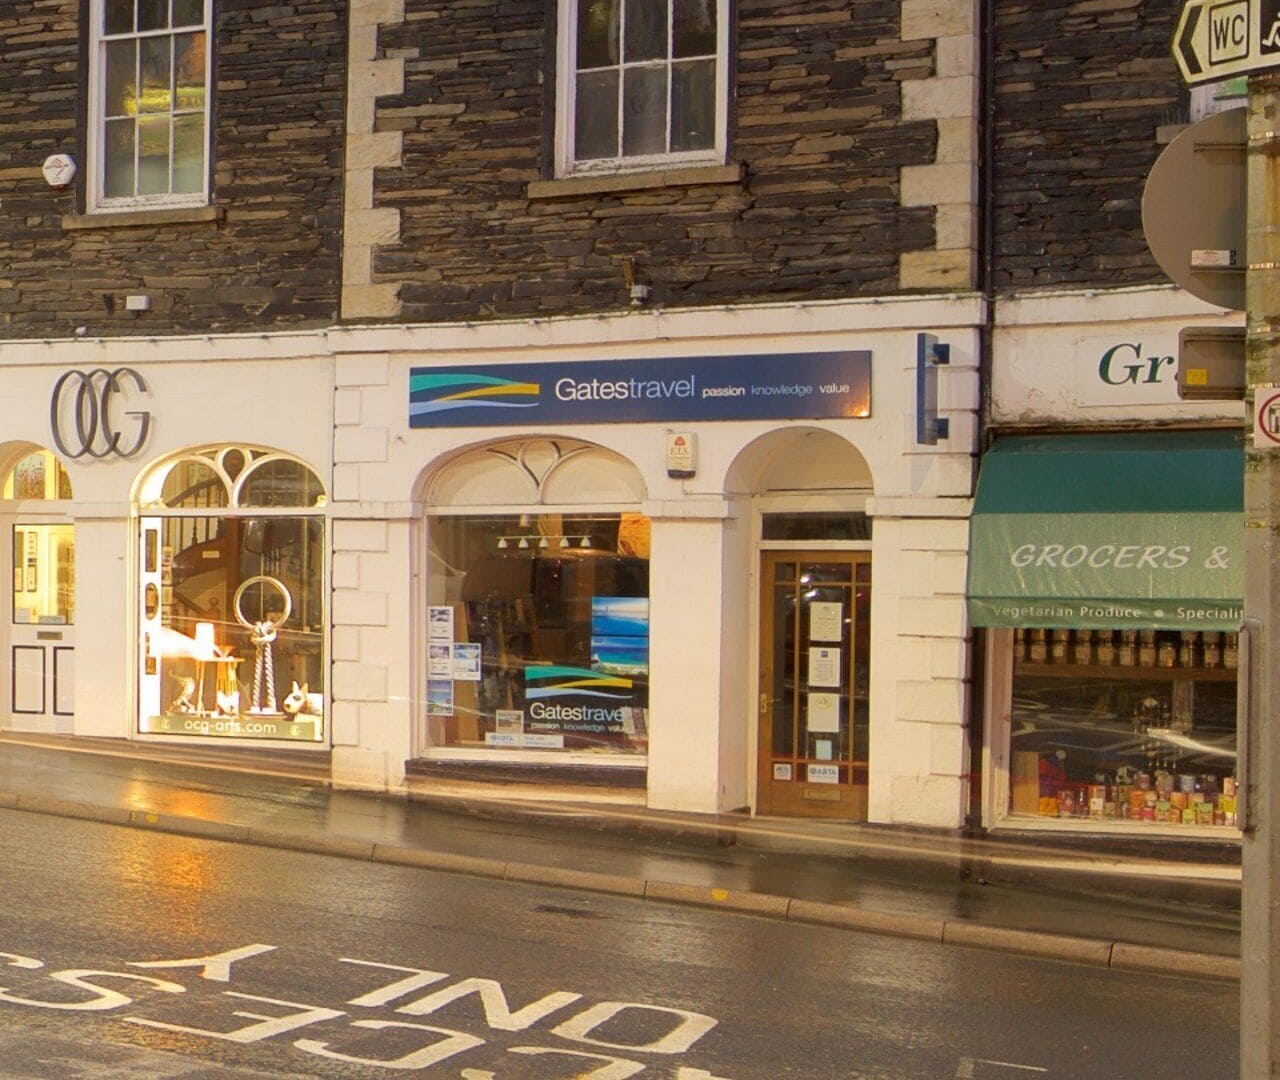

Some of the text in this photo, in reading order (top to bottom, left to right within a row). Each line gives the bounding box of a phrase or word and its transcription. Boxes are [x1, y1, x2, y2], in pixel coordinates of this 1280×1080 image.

[1213, 14, 1245, 51] WC
[1099, 342, 1178, 385] Gr
[555, 375, 850, 401] Gatestravel passion knowledge value
[1011, 544, 1232, 569] GROCERS &
[993, 606, 1073, 620] Vegetarian
[1080, 607, 1142, 619] Produce
[529, 702, 624, 721] Gatestrave
[563, 722, 605, 732] knowledge
[125, 943, 719, 1054] ONLY
